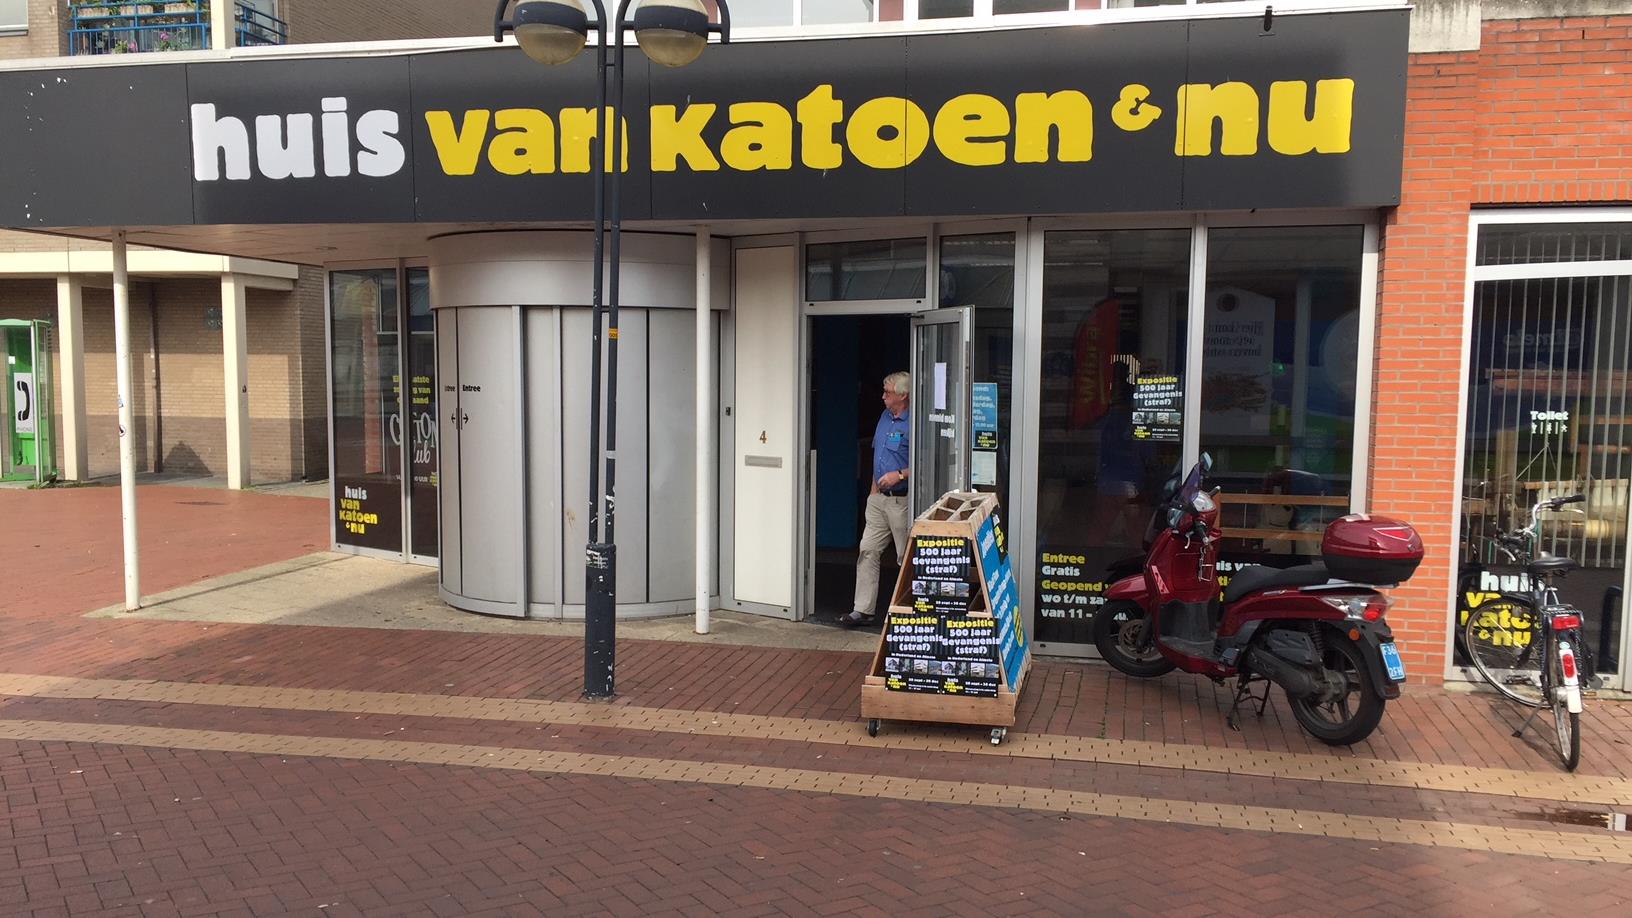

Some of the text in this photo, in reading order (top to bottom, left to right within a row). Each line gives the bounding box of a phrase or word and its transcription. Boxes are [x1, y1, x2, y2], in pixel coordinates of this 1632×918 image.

[190, 96, 405, 181] huis
[425, 107, 629, 175] van
[1111, 84, 1162, 132] &
[1175, 77, 1355, 157] nu
[463, 384, 481, 393] Entree
[1133, 391, 1183, 399] Gevangenis
[1530, 411, 1569, 421] Toilet
[759, 430, 767, 444] 4
[345, 486, 367, 499] huis
[340, 499, 360, 510] van
[350, 522, 365, 534] nu
[916, 539, 964, 549] Expositie
[920, 547, 962, 556] 500 jaar
[912, 556, 971, 566] Gevangenis
[1042, 553, 1085, 564] Entree
[925, 565, 958, 574] (straf)
[1042, 566, 1080, 577] Gratis
[1041, 580, 1102, 592] Geopend
[1041, 594, 1061, 603] wo
[1063, 592, 1087, 604] t/m
[1041, 608, 1065, 618] van
[1068, 608, 1083, 619] 11
[890, 616, 938, 626] Expositie
[946, 619, 994, 629] Expositie
[893, 625, 935, 634] 500 jaar
[949, 629, 991, 638] 500 jaar
[886, 634, 944, 643] Gevangenis
[942, 637, 1000, 646] Gevangenis
[1493, 630, 1531, 646] nu
[899, 642, 931, 652] (straf)
[955, 646, 988, 656] (straf)
